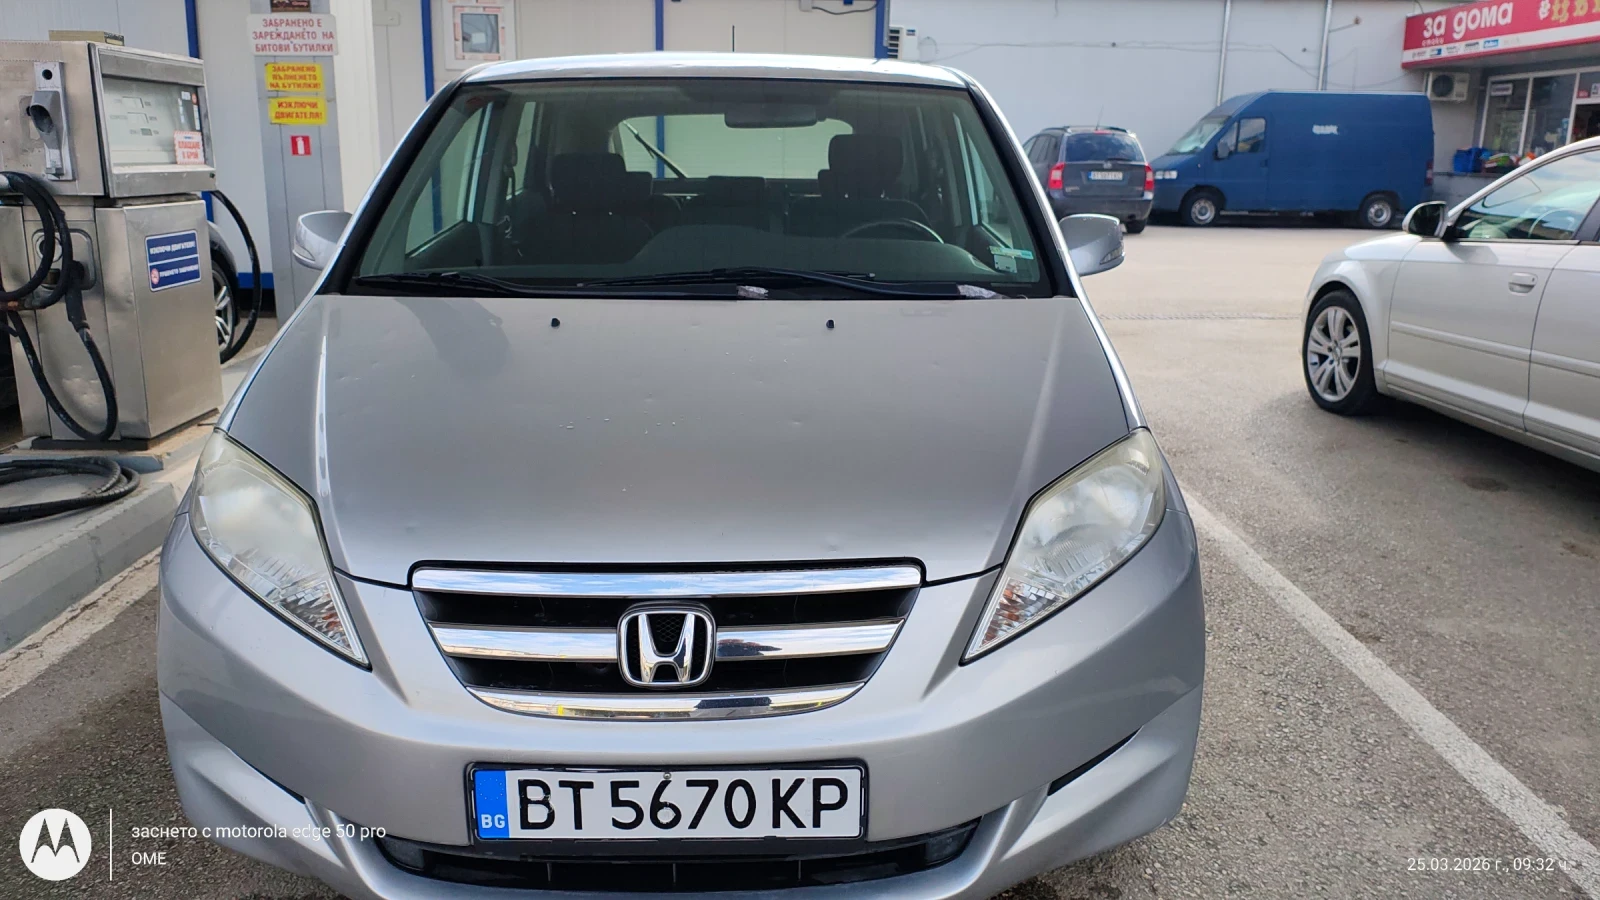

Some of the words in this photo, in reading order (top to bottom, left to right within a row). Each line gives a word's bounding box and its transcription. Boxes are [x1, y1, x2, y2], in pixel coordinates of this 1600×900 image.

[262, 18, 314, 28] ЗАБРАНЕНО
[317, 18, 322, 27] Е
[1452, 2, 1514, 40] дома
[252, 31, 317, 40] ЗАРЕЖДАНЕТО
[322, 31, 334, 39] НА
[255, 44, 290, 52] БИТОВИ
[293, 43, 334, 52] БУТИЛКИ
[518, 778, 594, 830] BT
[610, 778, 757, 830] 5670
[771, 778, 850, 828] KP
[480, 814, 506, 829] BG
